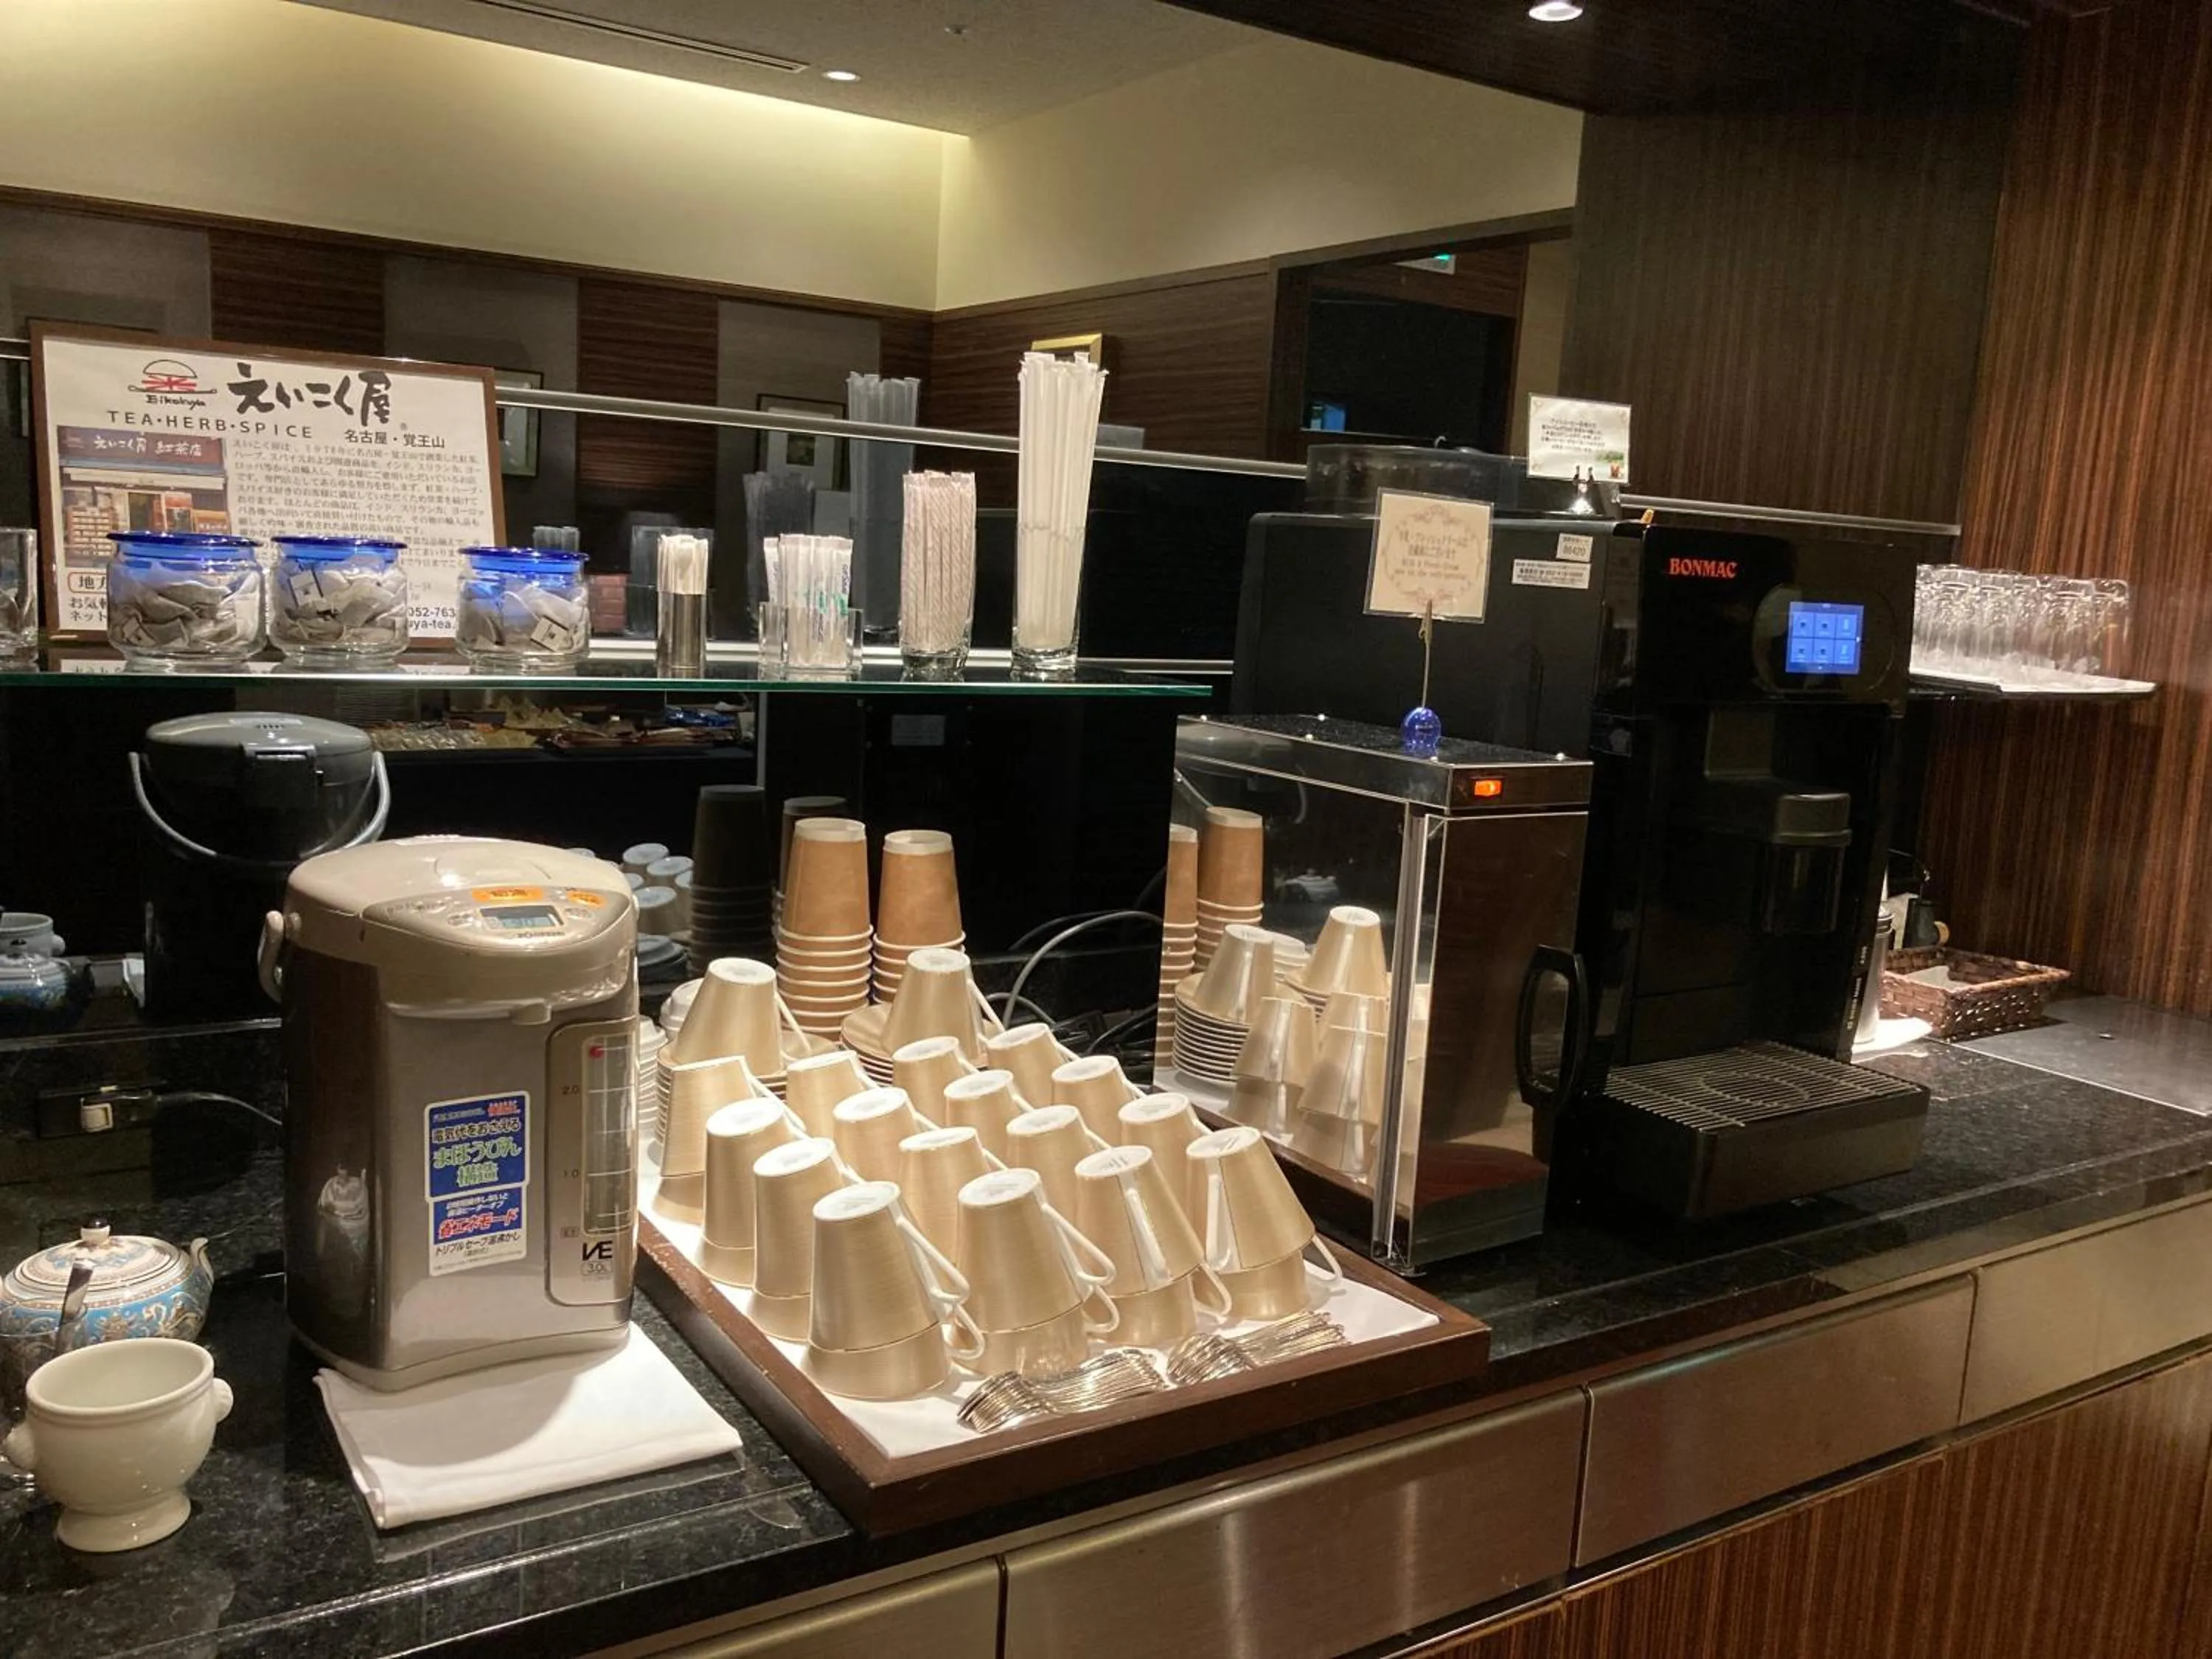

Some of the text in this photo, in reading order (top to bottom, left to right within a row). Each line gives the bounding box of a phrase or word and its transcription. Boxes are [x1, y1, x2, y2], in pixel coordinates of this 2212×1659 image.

[226, 362, 392, 426] えいこく屋
[1669, 557, 1737, 578] BONMAC
